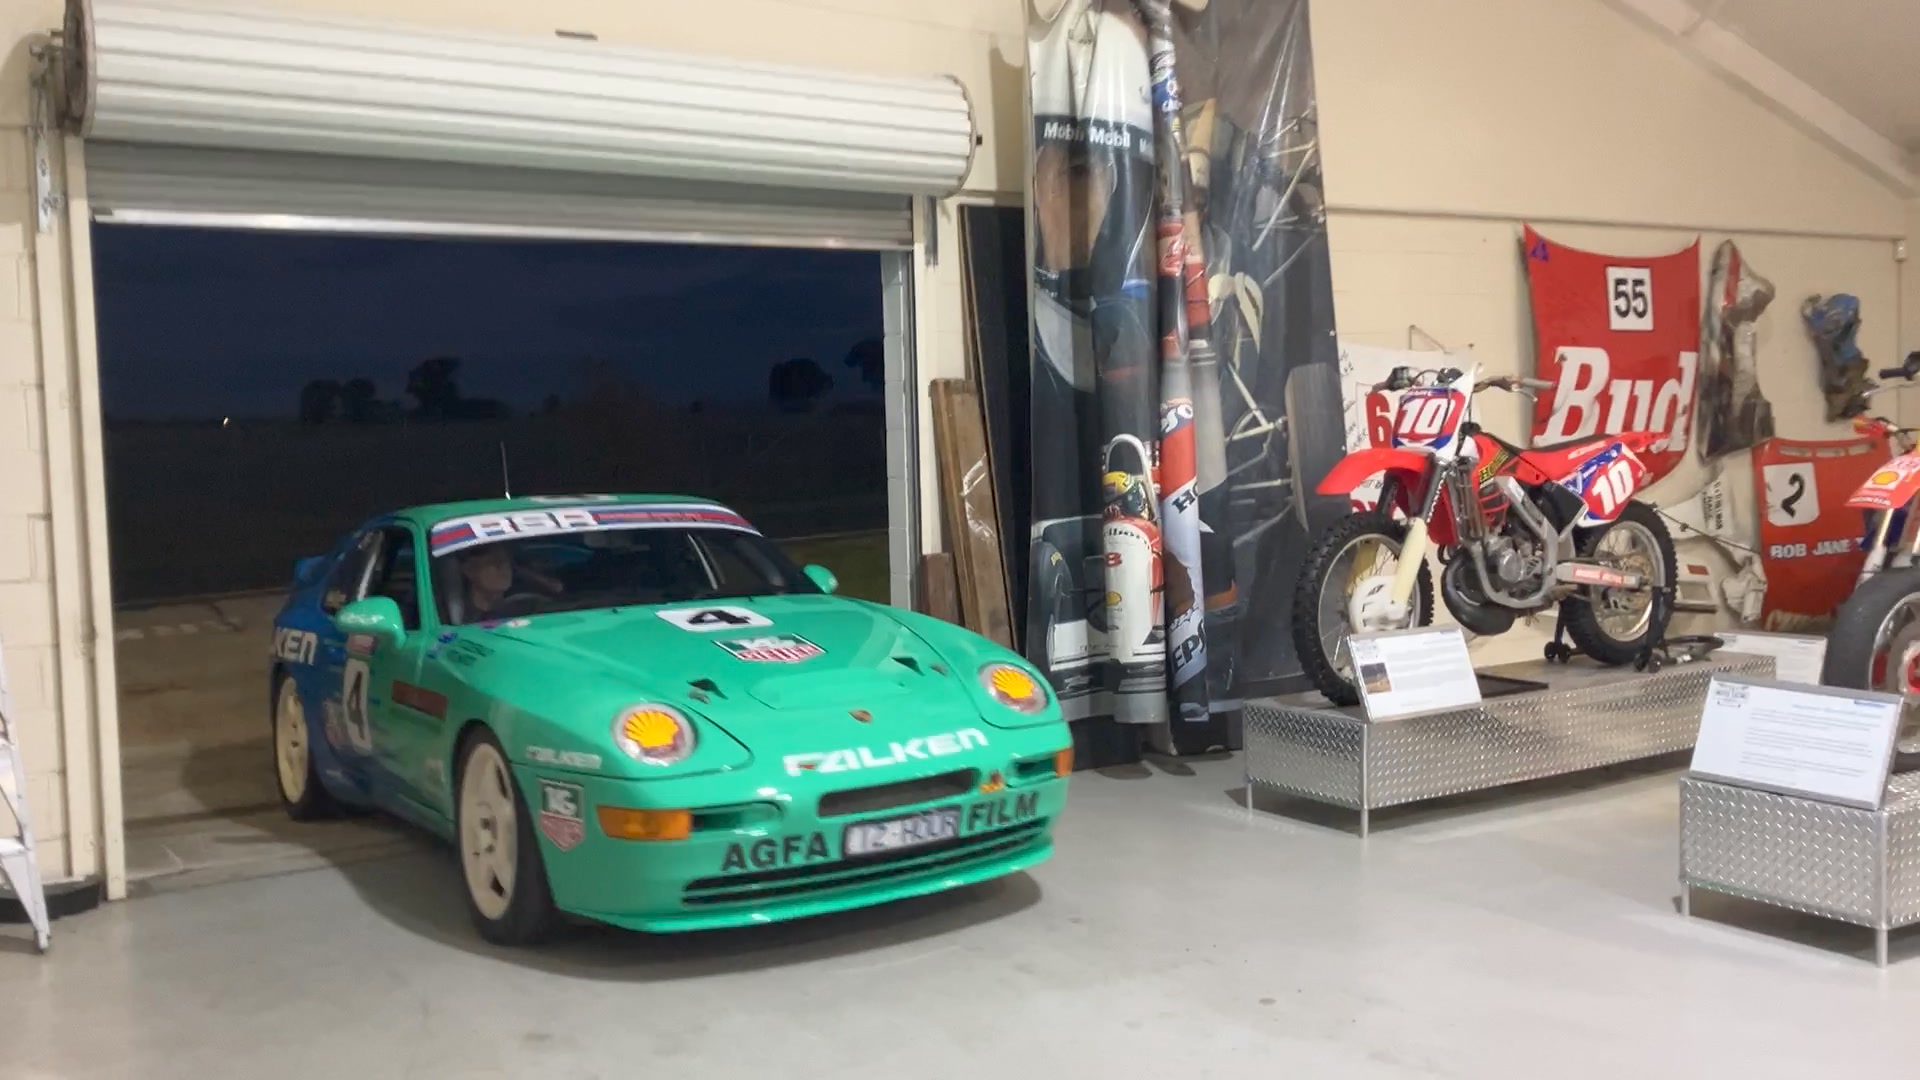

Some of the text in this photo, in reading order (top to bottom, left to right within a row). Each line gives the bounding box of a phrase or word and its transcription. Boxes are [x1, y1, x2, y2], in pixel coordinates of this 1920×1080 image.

[1089, 124, 1131, 149] Mobil
[1614, 278, 1649, 319] 55
[1398, 398, 1449, 435] 10
[1533, 346, 1698, 454] Bud
[1591, 460, 1634, 515] 10
[1781, 472, 1804, 518] 2
[1770, 543, 1808, 559] BOB
[1813, 539, 1851, 556] JANE
[687, 609, 752, 625] 4
[346, 670, 367, 742] 4
[783, 727, 990, 777] FALKEN
[721, 791, 1039, 872] AGFA FILM
